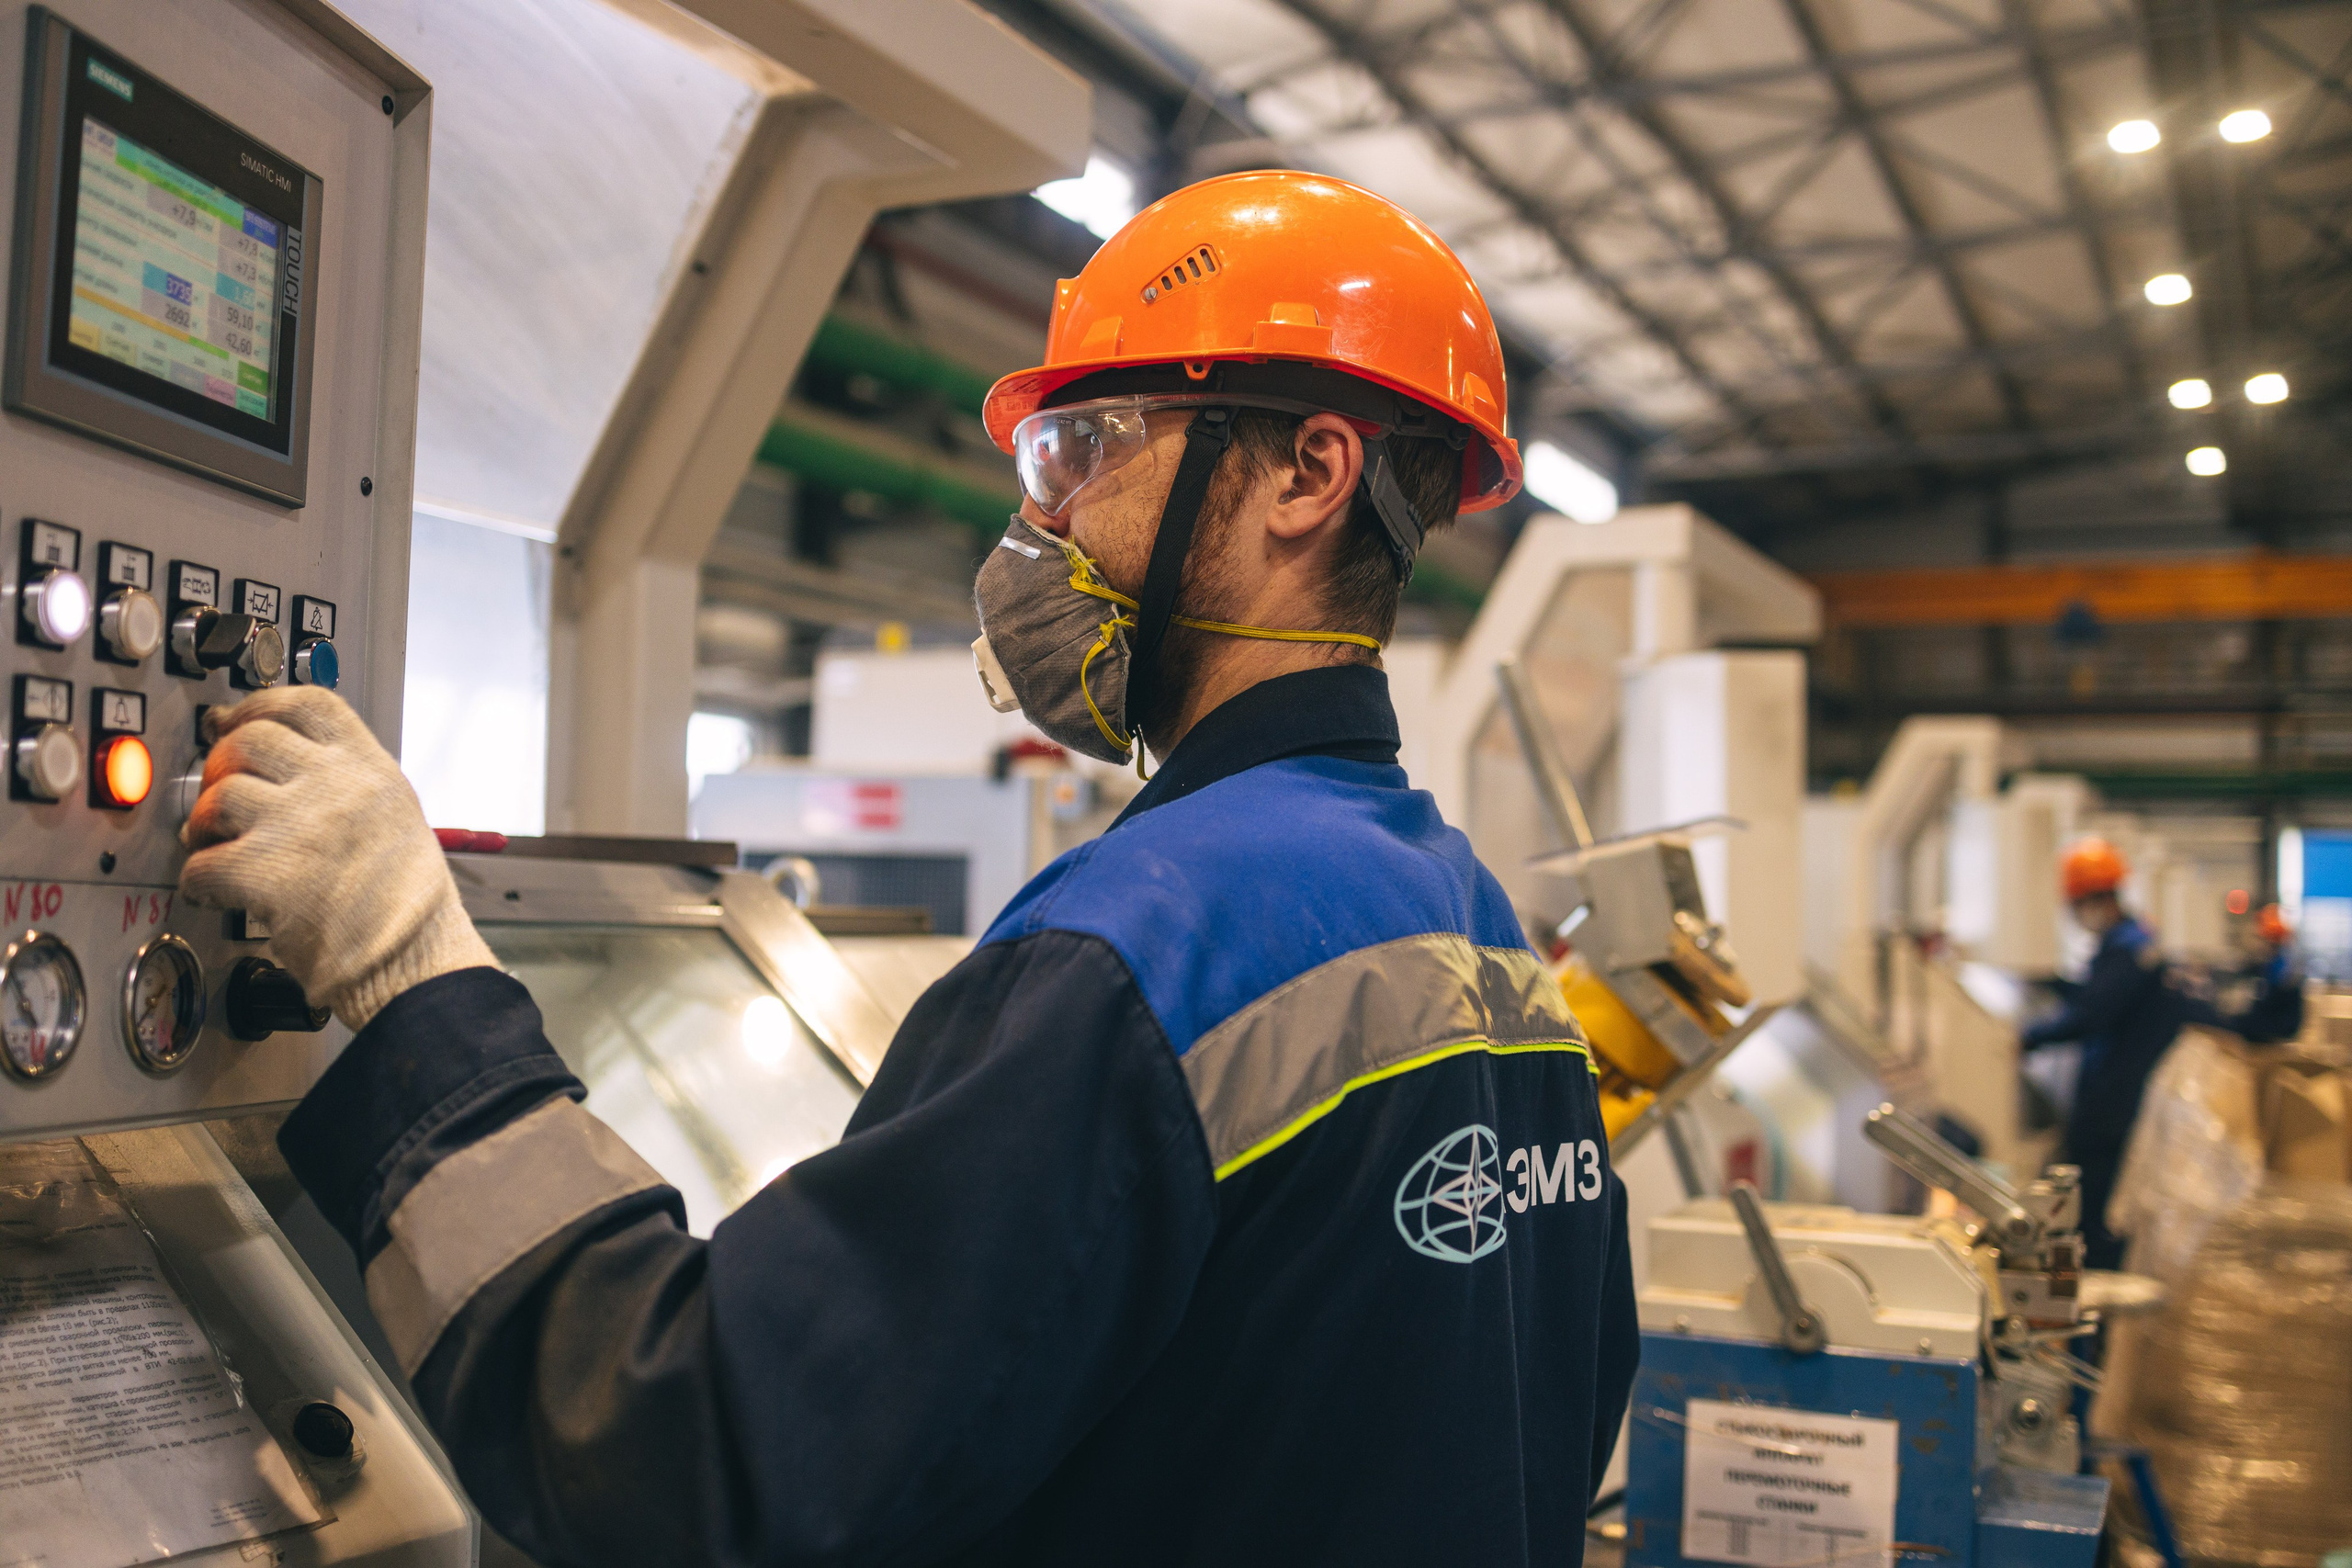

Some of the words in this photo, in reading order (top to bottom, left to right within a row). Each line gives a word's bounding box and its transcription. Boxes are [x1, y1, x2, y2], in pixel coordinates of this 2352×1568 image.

[240, 152, 275, 183] SIMATIC
[275, 173, 292, 193] HMI
[284, 234, 302, 315] TOUCH
[1506, 1139, 1602, 1213] ЭМЗ
[62, 1321, 73, 1330] 10
